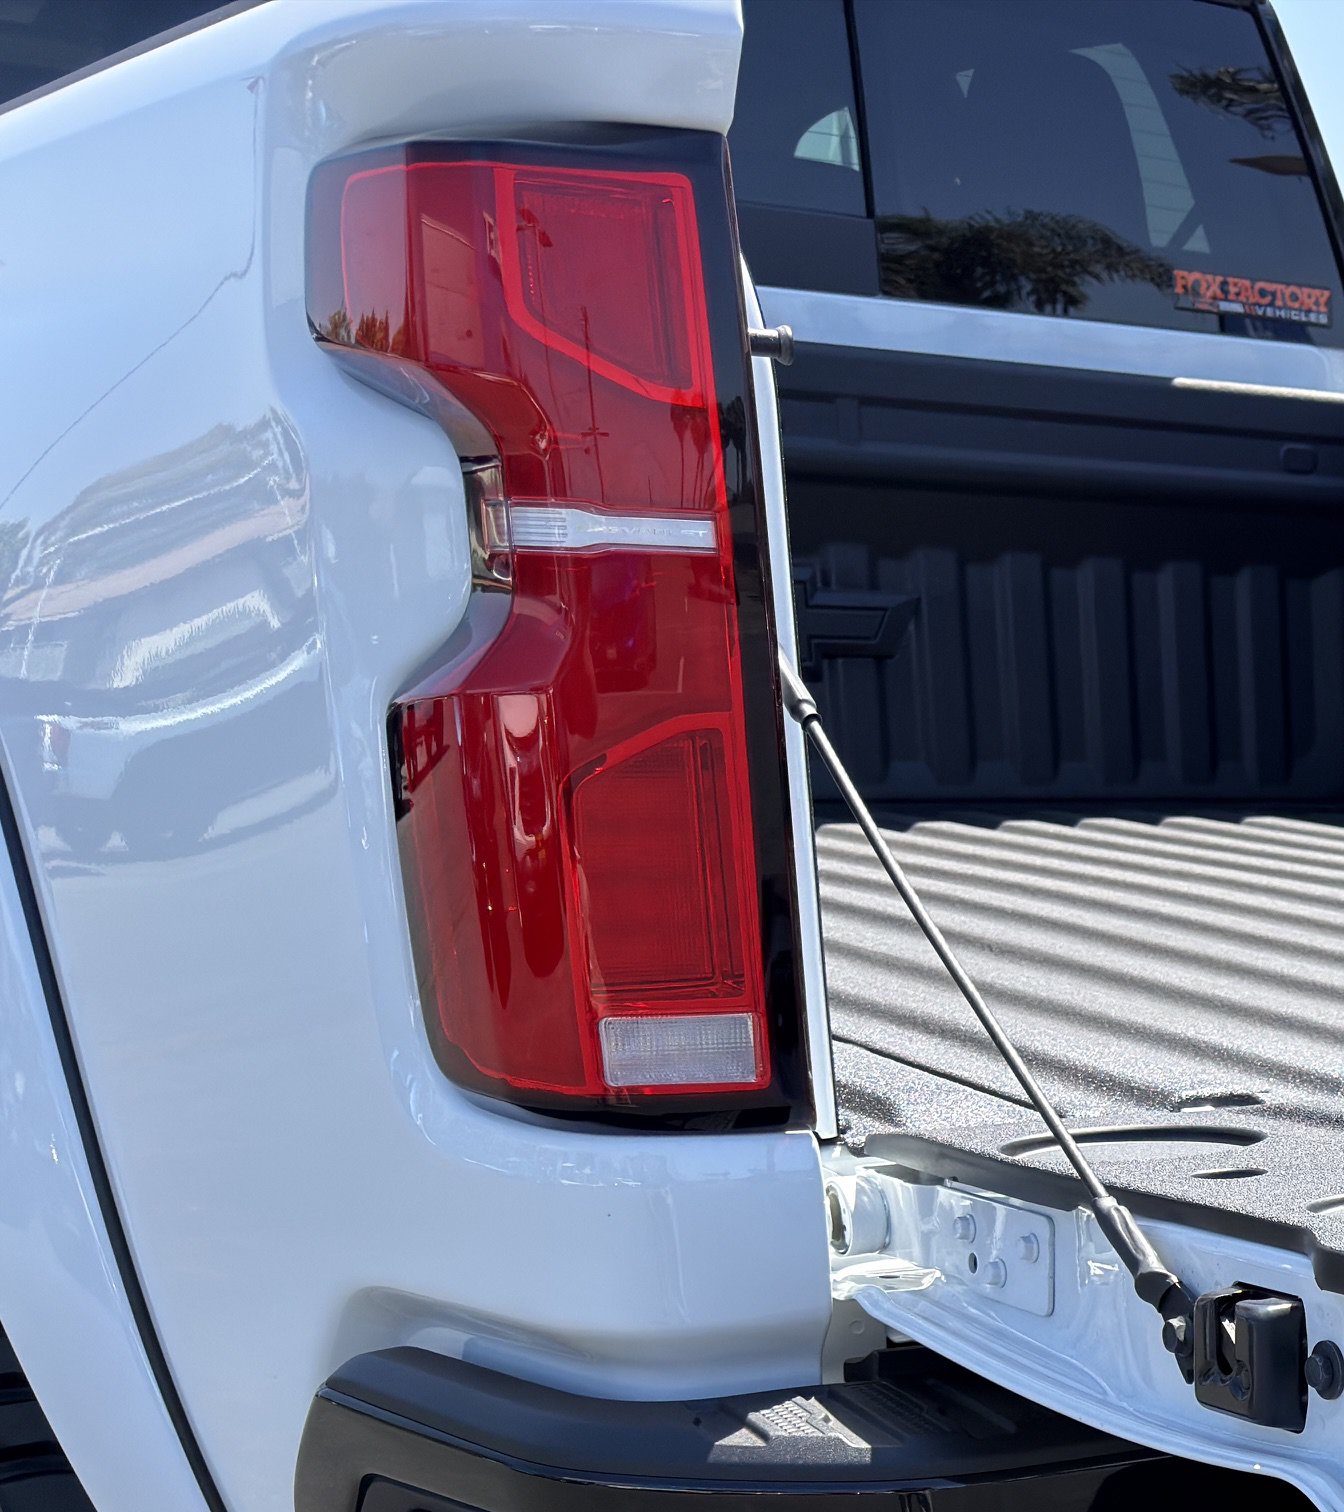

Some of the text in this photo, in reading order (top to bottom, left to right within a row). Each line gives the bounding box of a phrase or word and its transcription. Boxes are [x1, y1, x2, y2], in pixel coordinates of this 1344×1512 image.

[1173, 270, 1331, 312] FOX FACTORY
[1255, 305, 1329, 324] VEHICLES
